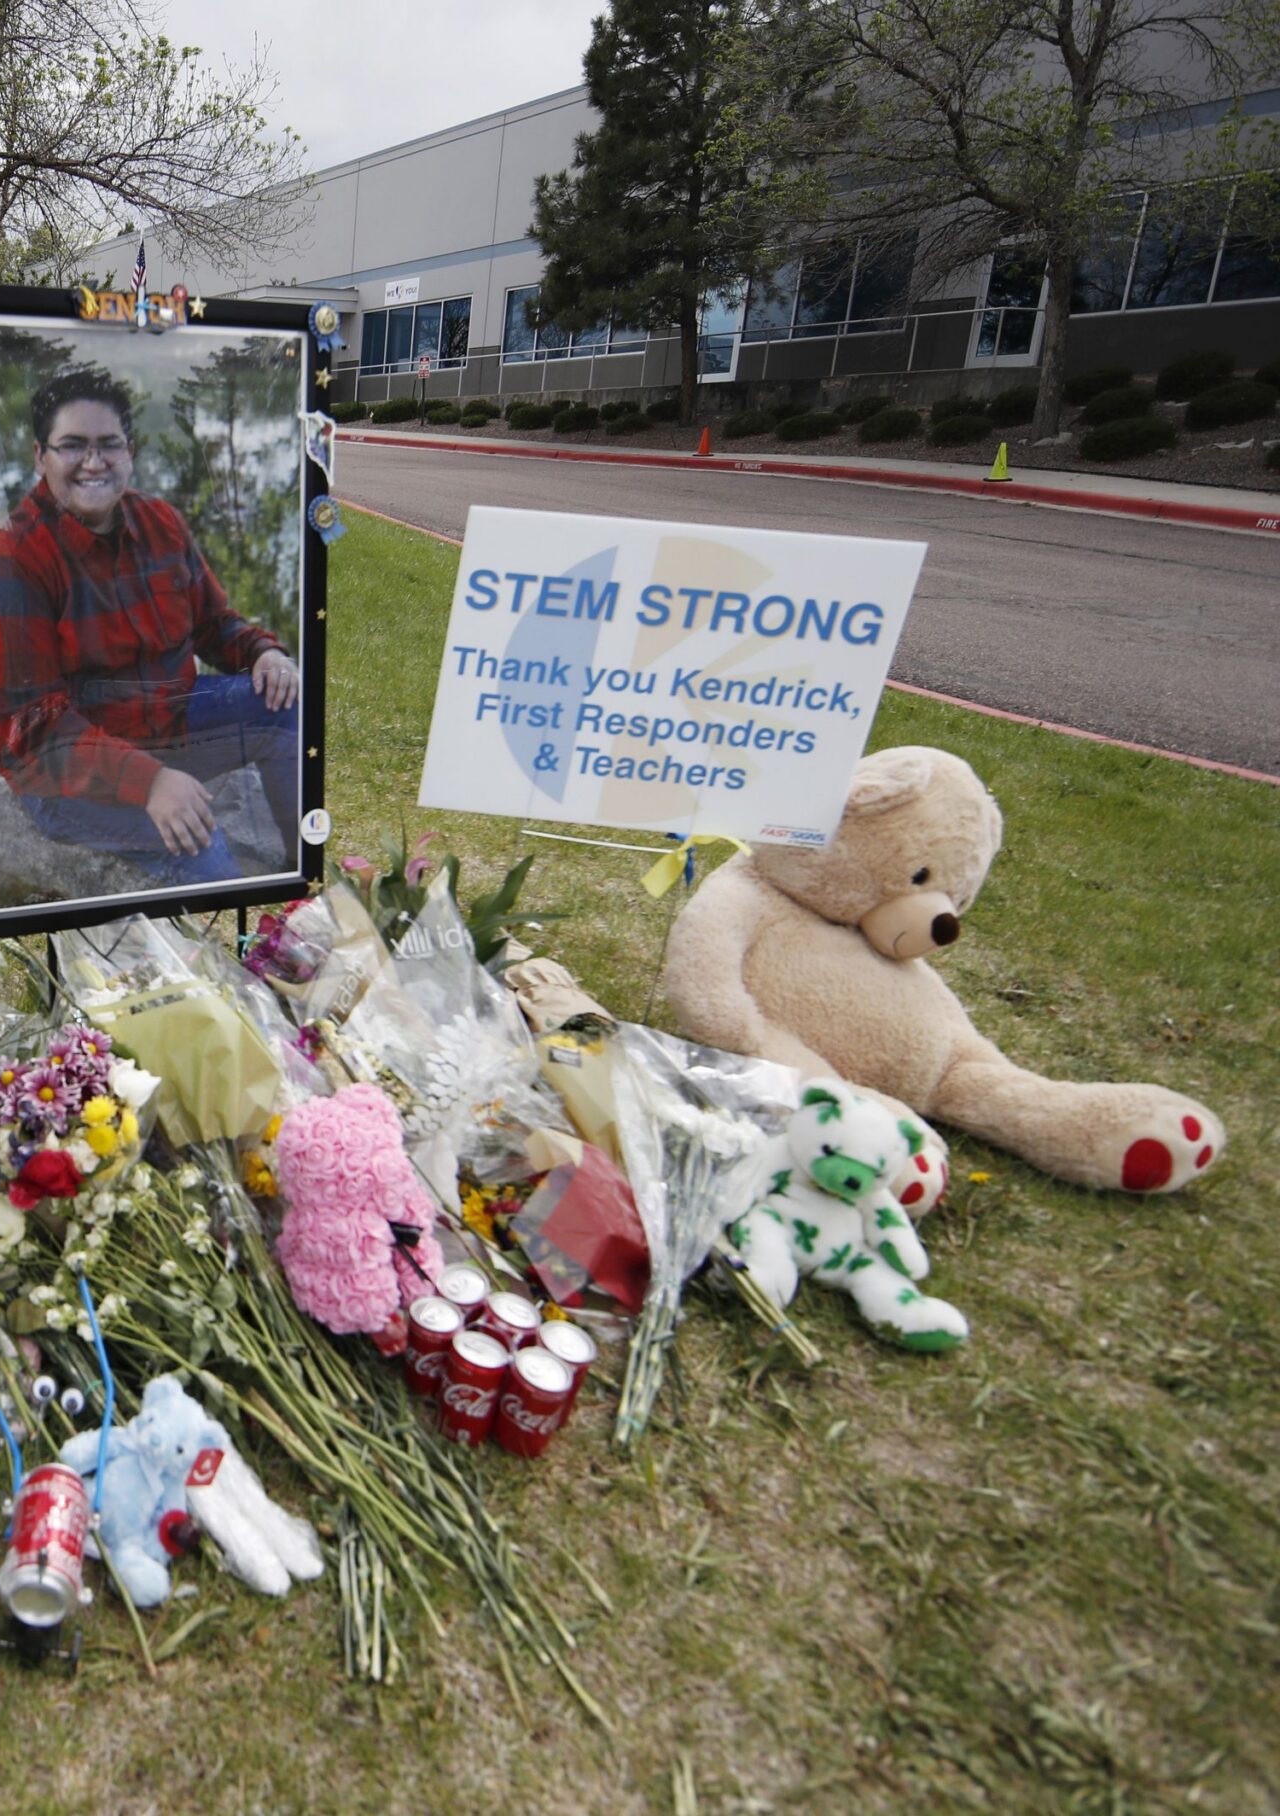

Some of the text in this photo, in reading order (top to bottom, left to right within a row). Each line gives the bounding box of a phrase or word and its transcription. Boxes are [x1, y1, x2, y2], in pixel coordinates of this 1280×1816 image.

[1256, 518, 1280, 530] FIRE
[466, 569, 885, 645] STEM STRONG
[453, 646, 861, 719] Thank you Kendrick,
[476, 693, 816, 754] First Responders
[533, 743, 747, 790] & Teachers
